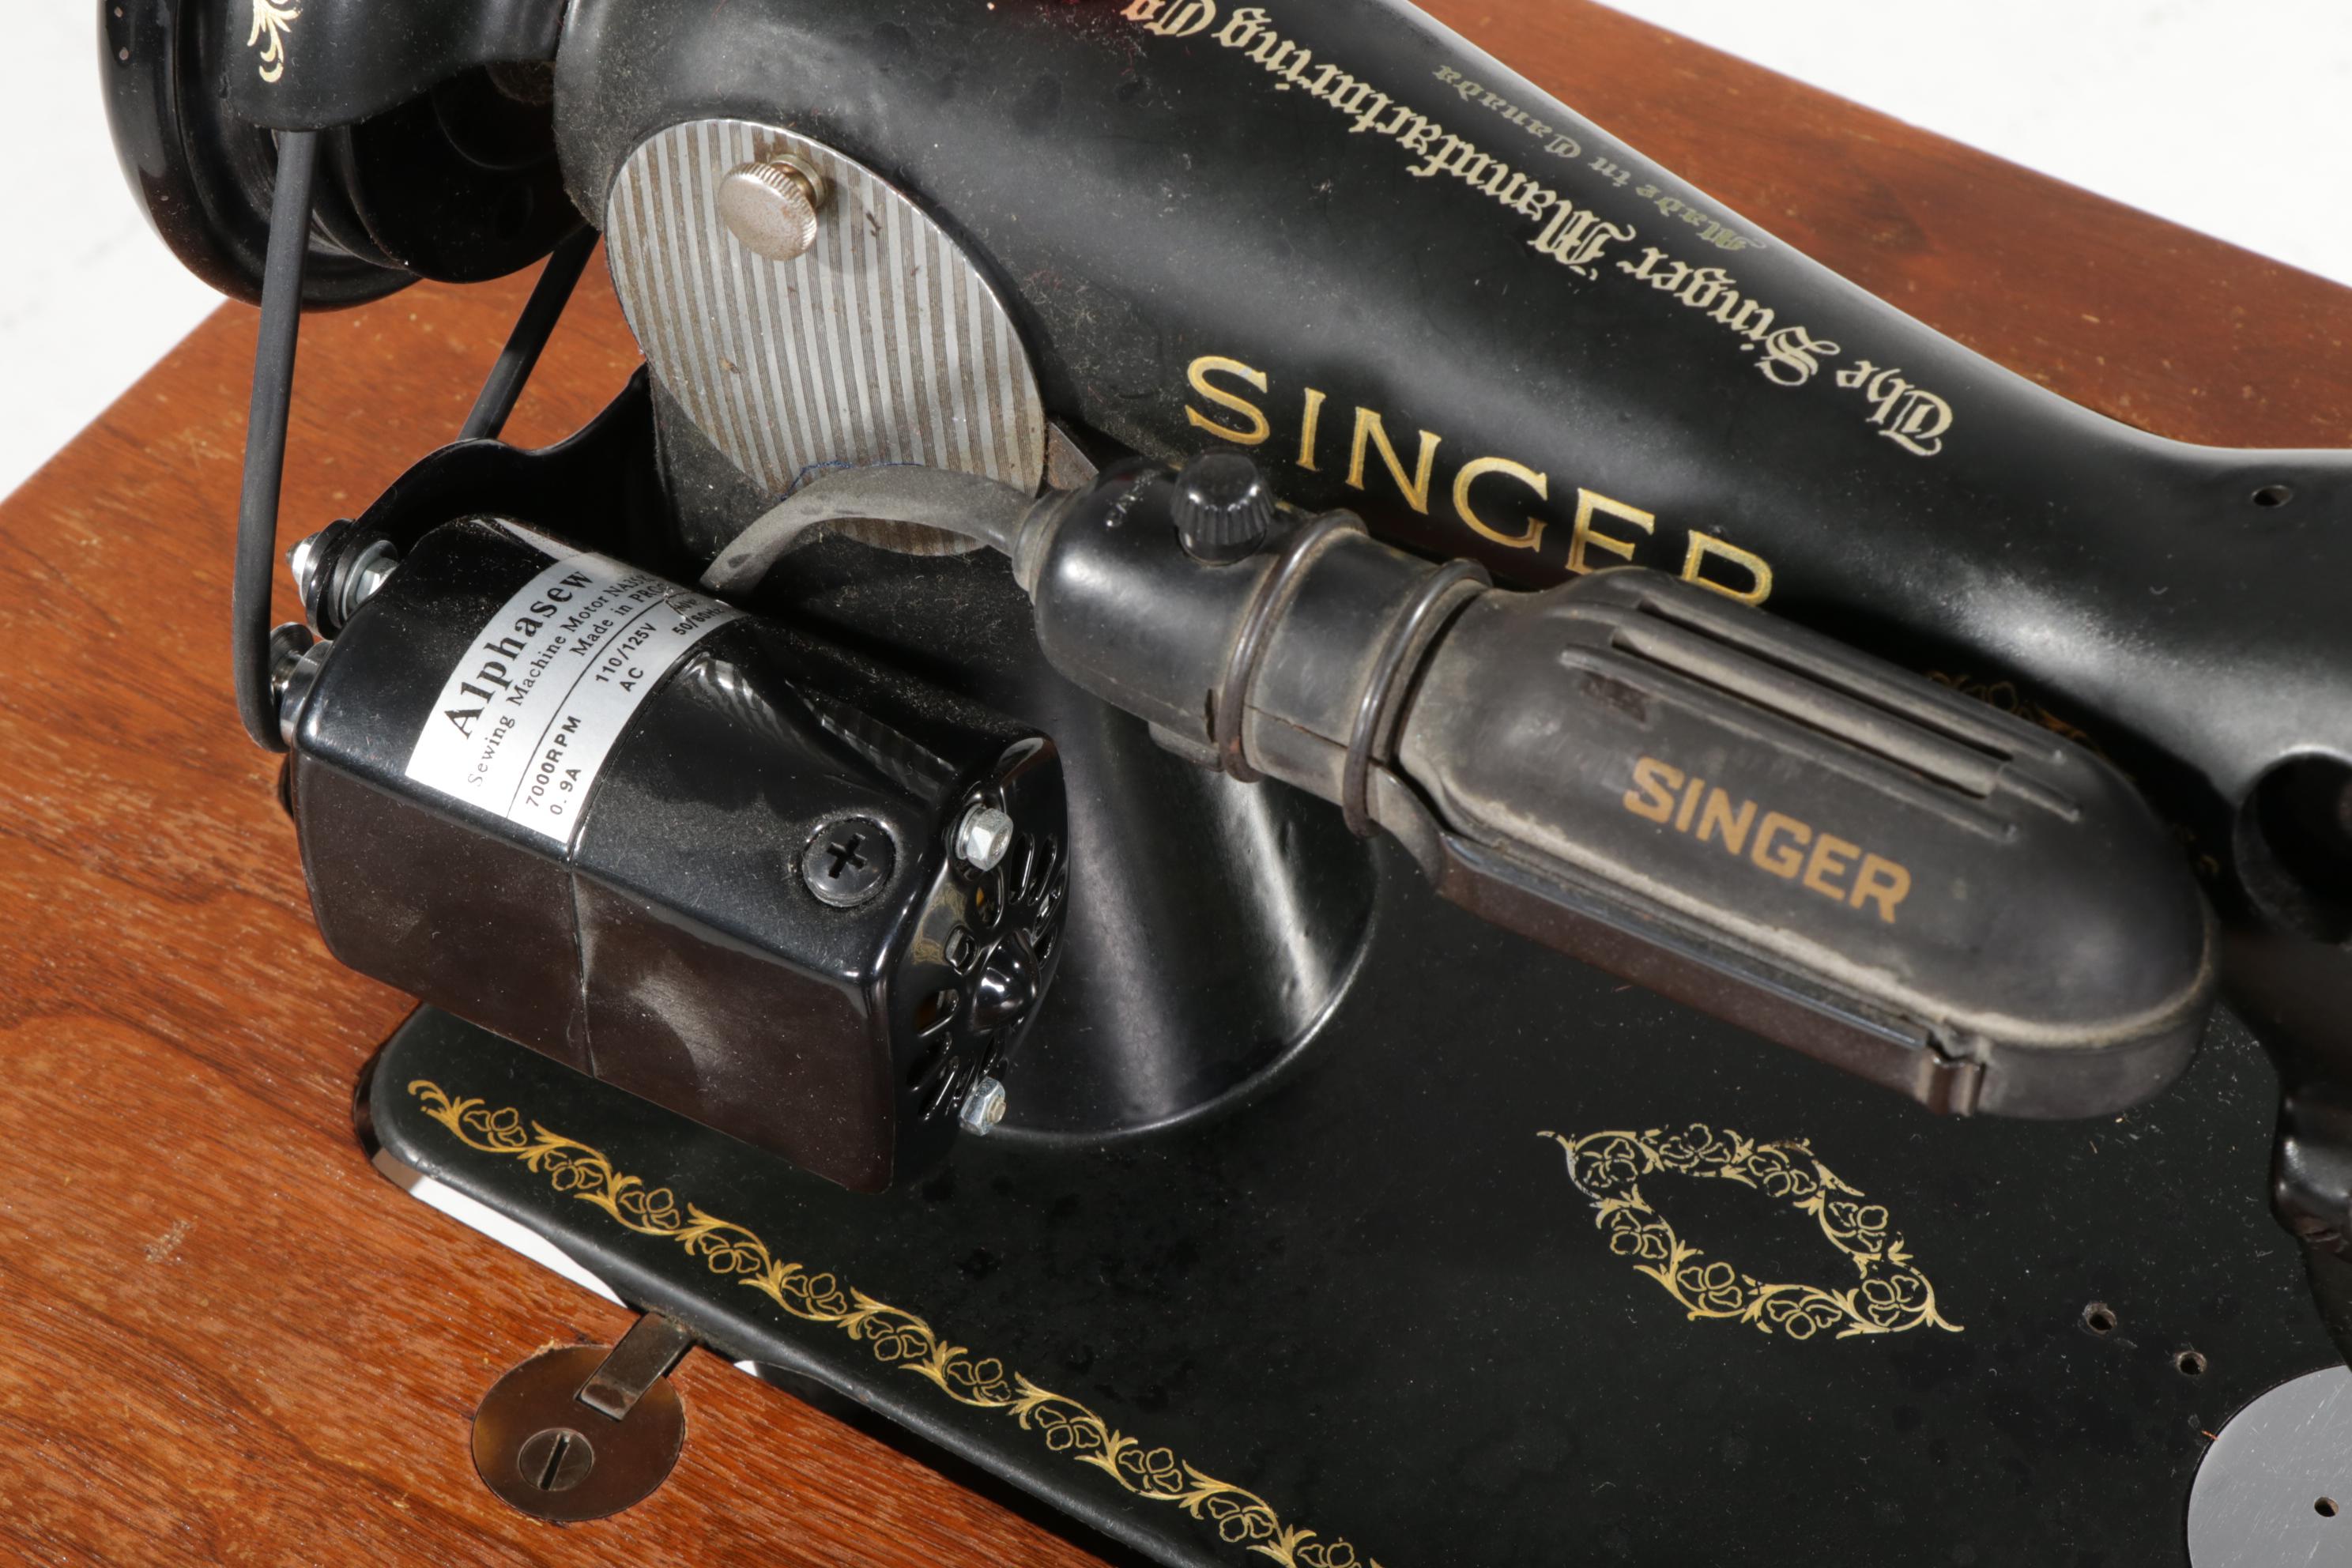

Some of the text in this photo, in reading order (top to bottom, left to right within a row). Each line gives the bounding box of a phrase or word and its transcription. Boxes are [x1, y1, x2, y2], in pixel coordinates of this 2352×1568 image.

[1212, 7, 1635, 280] Manufacturing
[1433, 65, 1766, 250] Made in Canada
[1617, 247, 1840, 386] Singer
[1185, 356, 1773, 607] SINGER
[1836, 360, 1953, 456] The
[443, 571, 593, 740] Alphasew
[468, 714, 516, 788] Sewing
[506, 635, 567, 707] Machine
[560, 595, 609, 633] Motor
[569, 619, 614, 657] Made
[610, 604, 633, 616] in
[620, 667, 644, 693] AC
[526, 623, 657, 808] 7000RPM 110/125V
[1623, 756, 1911, 923] SINGER
